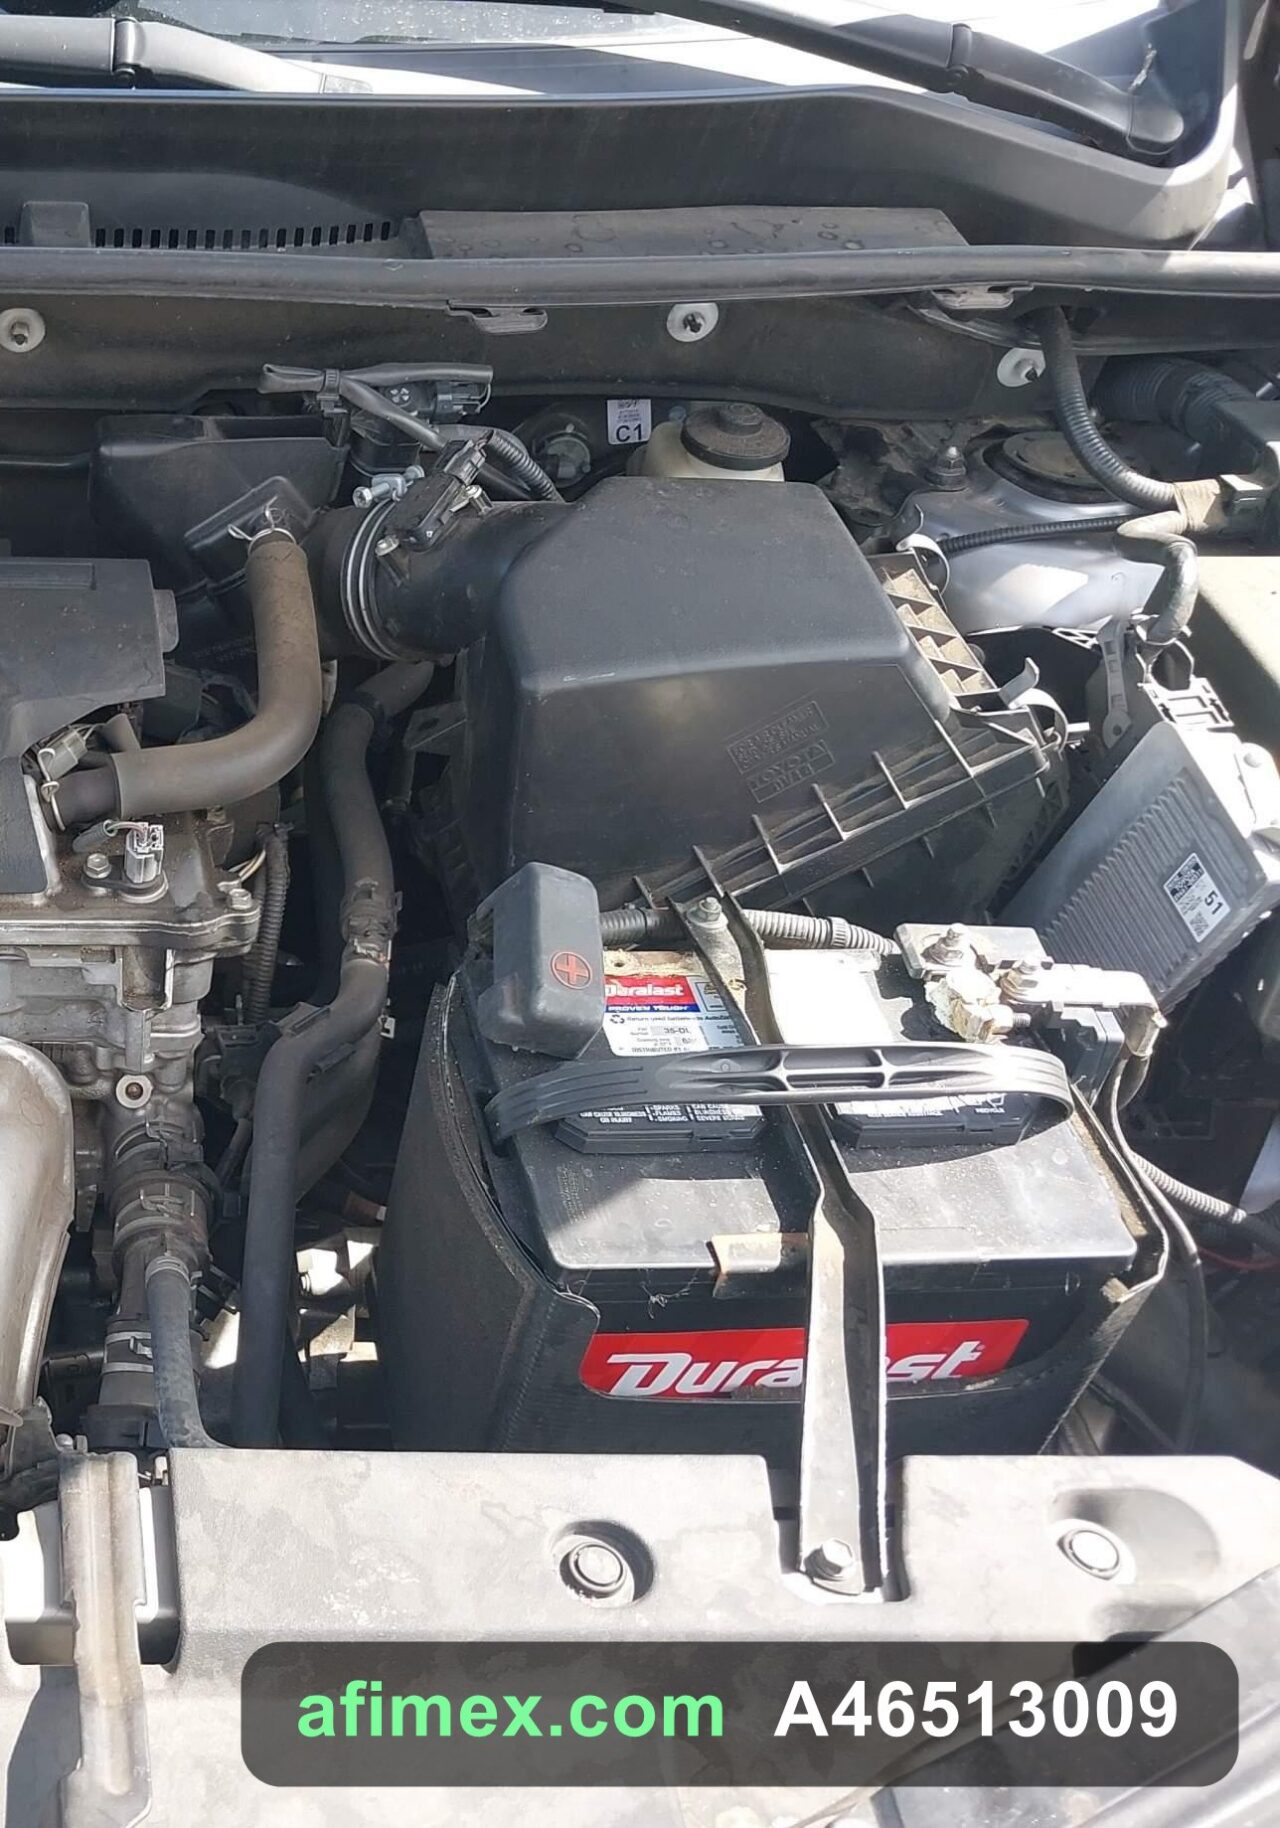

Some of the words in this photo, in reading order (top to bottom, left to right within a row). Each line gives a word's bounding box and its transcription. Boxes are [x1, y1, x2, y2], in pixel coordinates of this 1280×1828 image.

[616, 423, 642, 442] C1
[1204, 890, 1223, 915] 51
[606, 1341, 982, 1396] Durast
